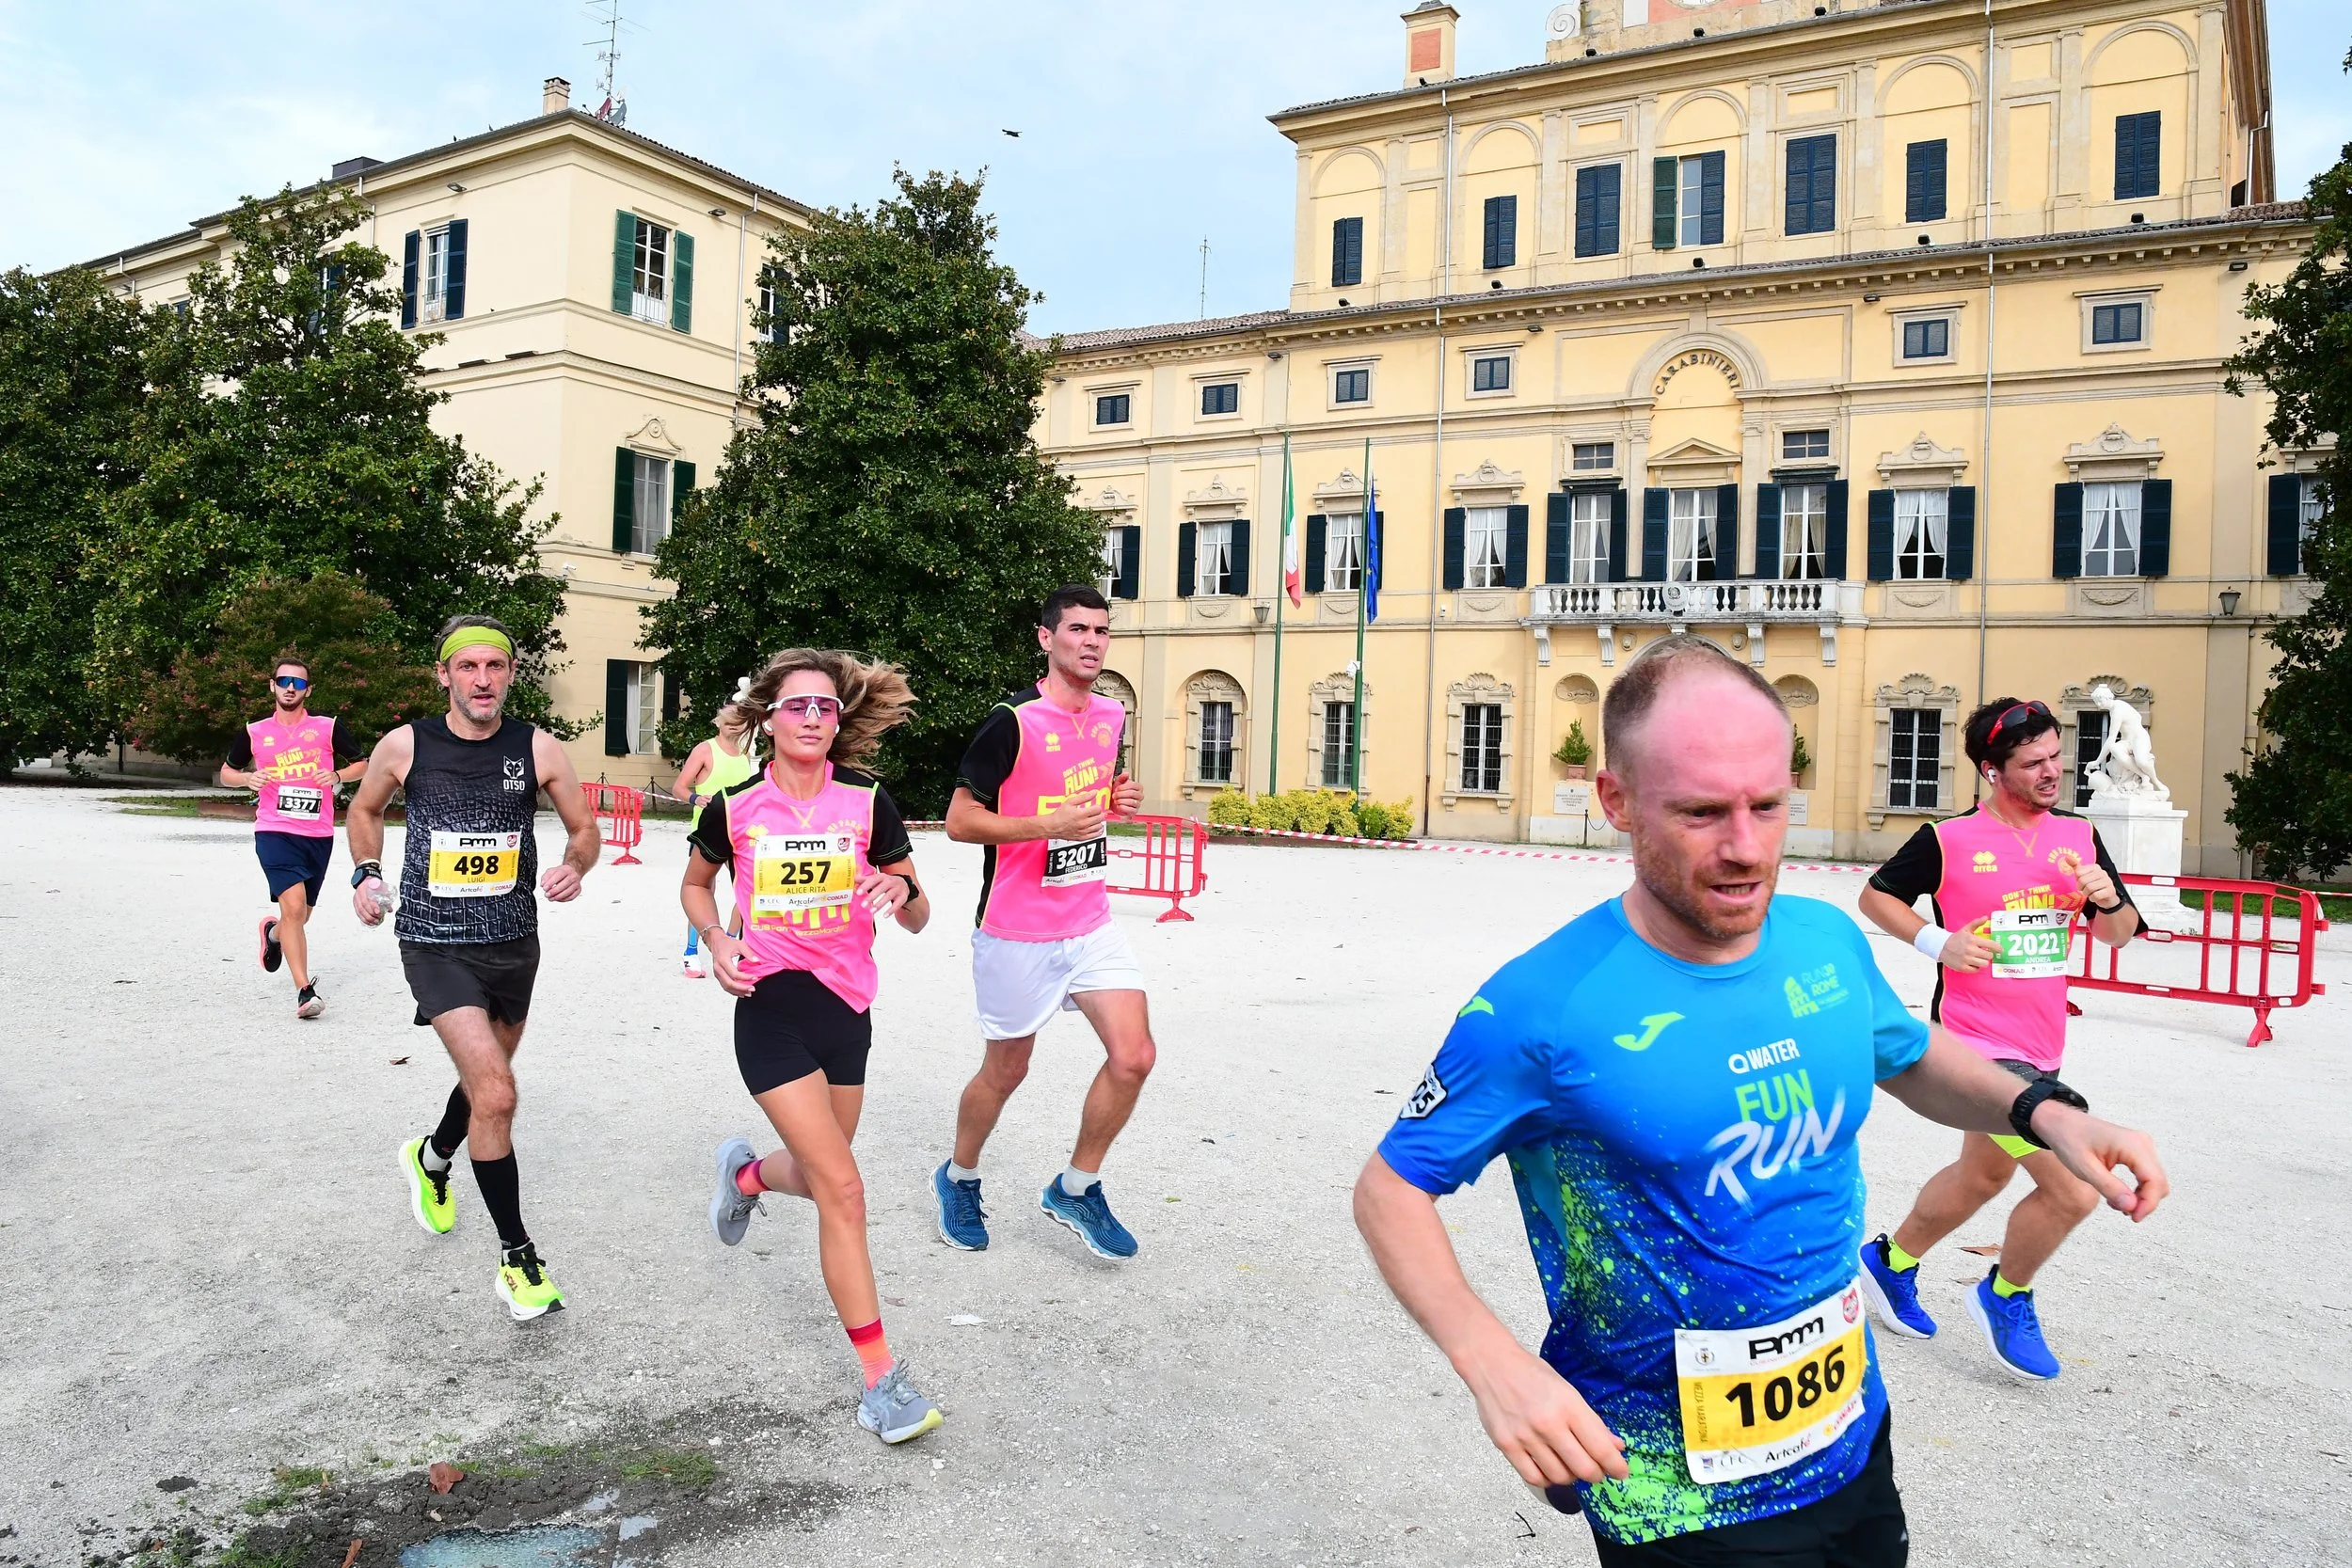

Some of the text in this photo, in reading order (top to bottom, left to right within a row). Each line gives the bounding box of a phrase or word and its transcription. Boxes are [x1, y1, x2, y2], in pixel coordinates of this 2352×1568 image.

[1656, 354, 1740, 395] CARABINIERI
[503, 780, 525, 791] OTSO
[1064, 766, 1099, 797] RUN!
[285, 797, 316, 810] 3377
[454, 856, 500, 875] 498
[1057, 843, 1097, 870] 3207
[1065, 863, 1088, 874] FEDERICO
[781, 861, 831, 885] 257
[2002, 884, 2051, 903] DON'T THINK
[2008, 932, 2059, 956] 2022
[1735, 1069, 1814, 1122] FUN
[1701, 1083, 1846, 1212] RUN
[1725, 1344, 1845, 1428] 1086
